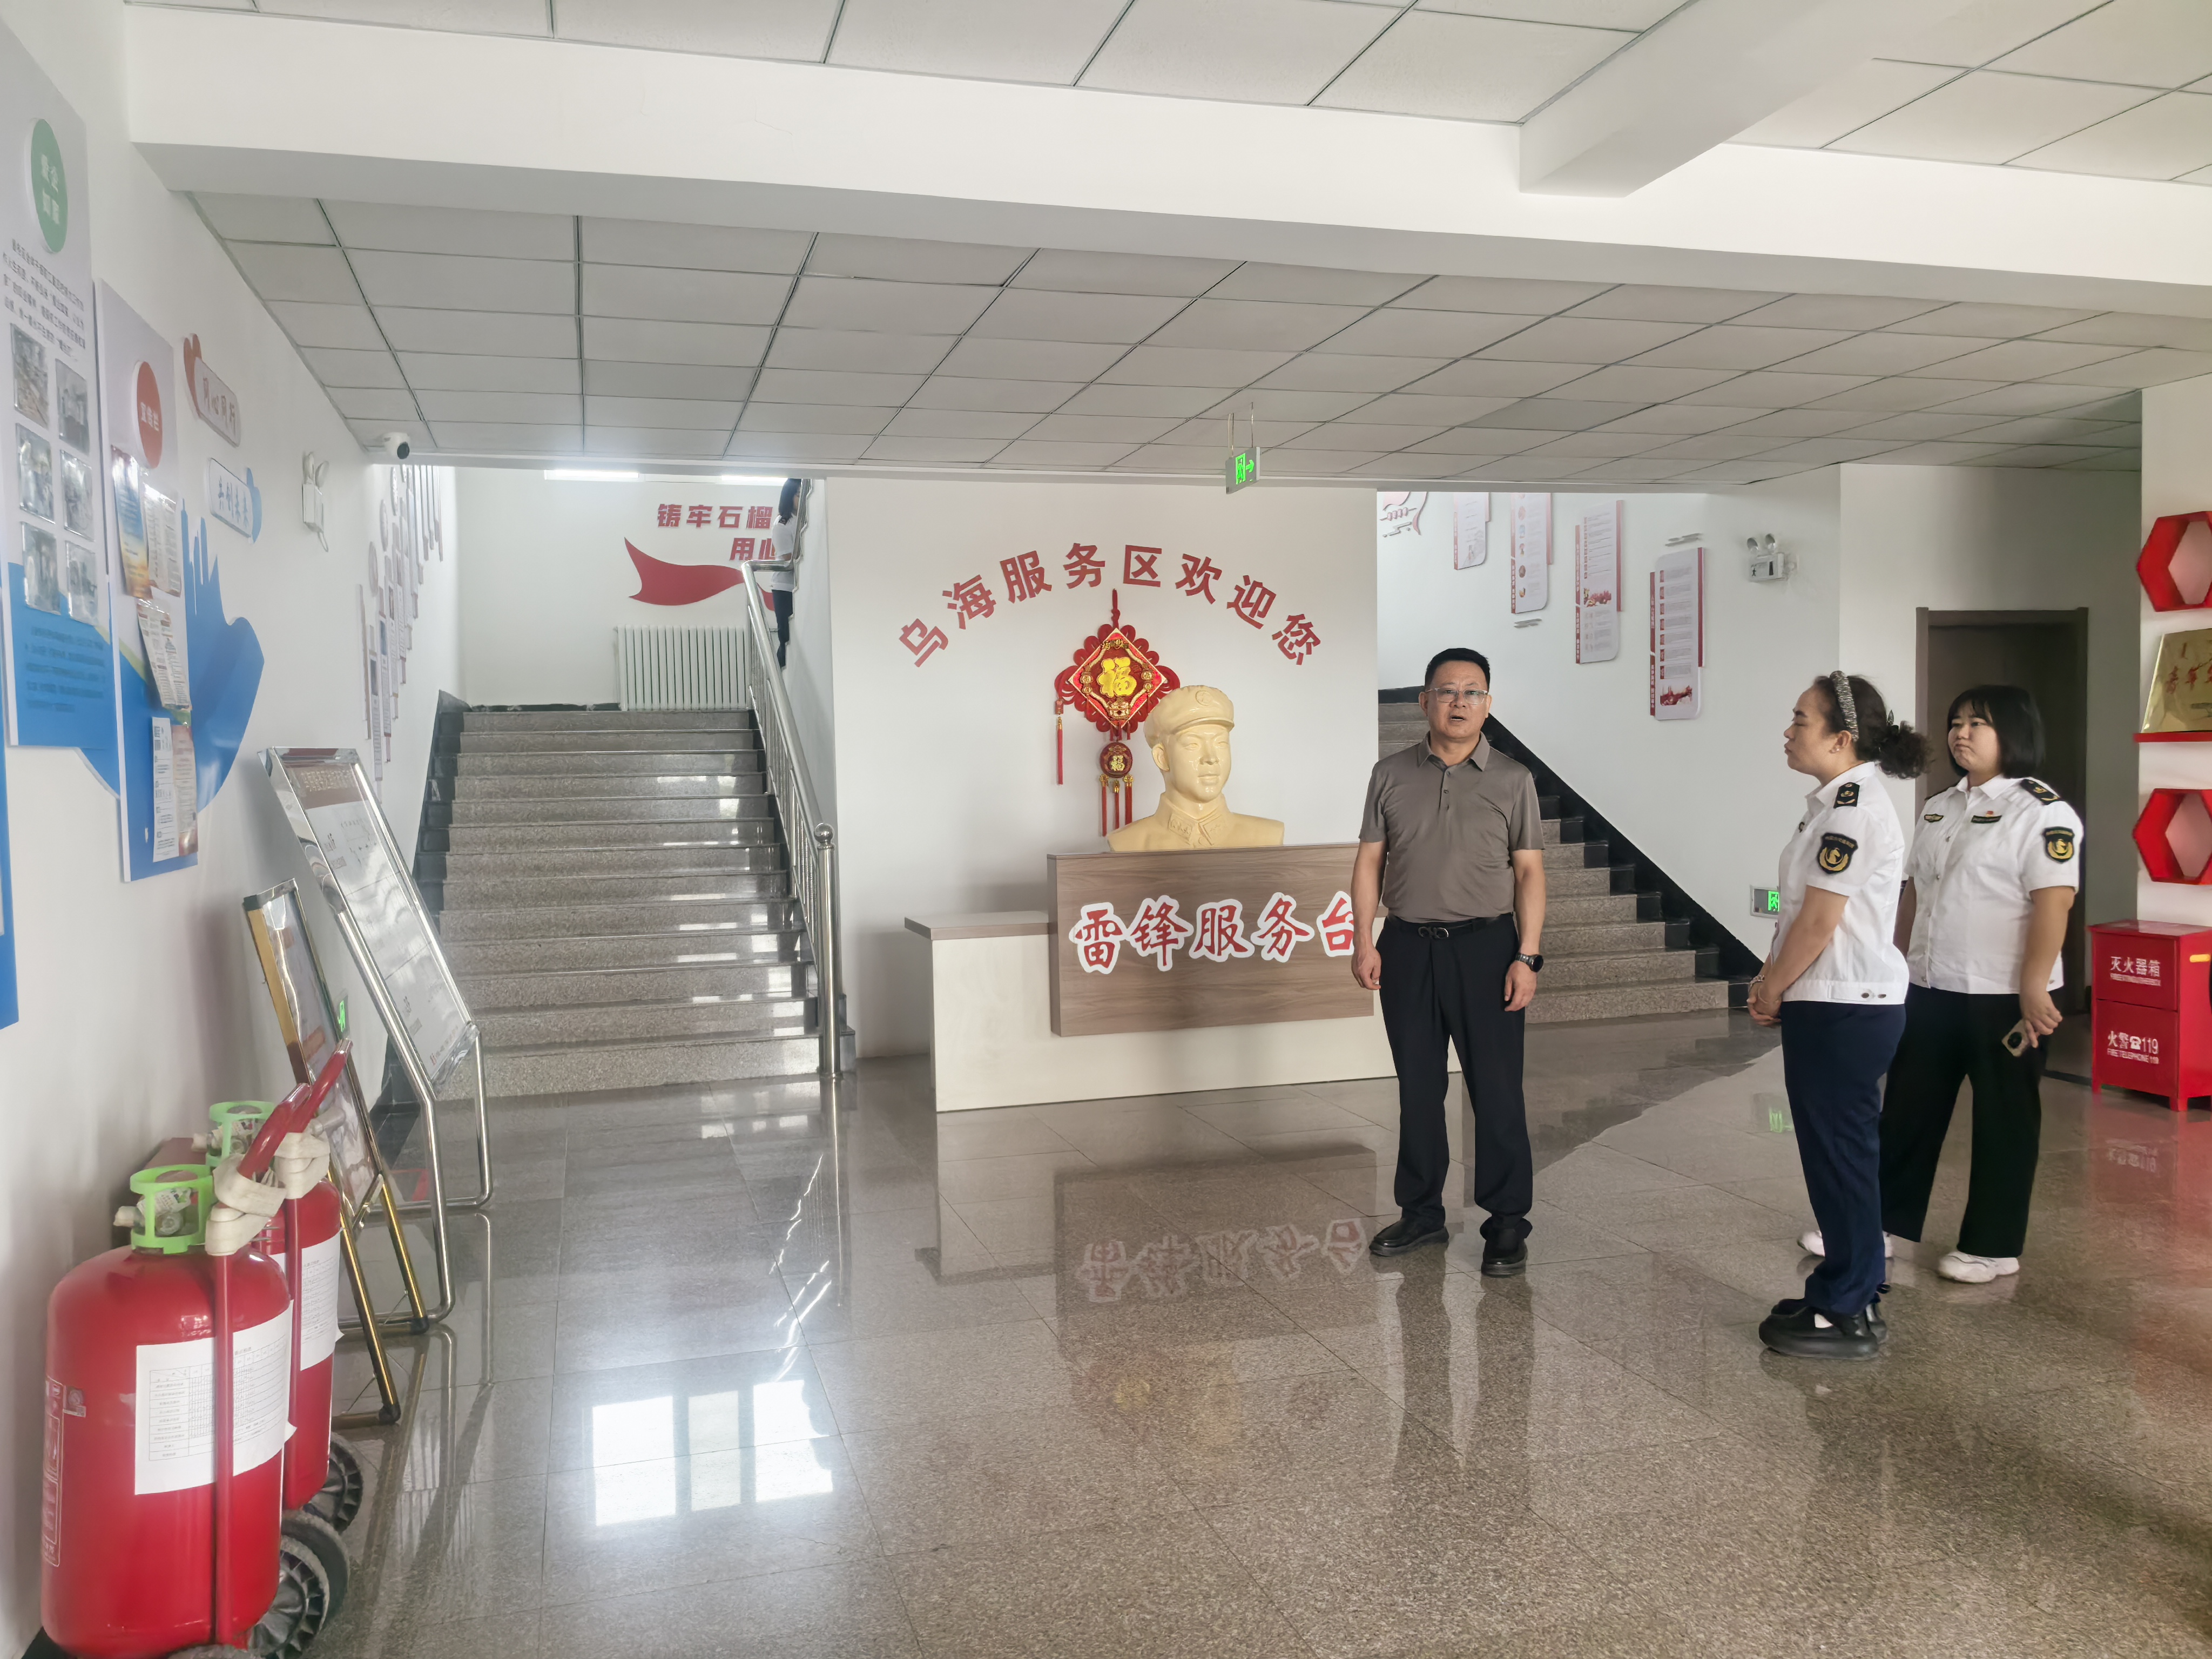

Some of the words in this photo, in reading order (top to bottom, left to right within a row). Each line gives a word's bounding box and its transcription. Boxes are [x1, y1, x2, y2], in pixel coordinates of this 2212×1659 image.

[657, 503, 773, 530] 铸牢石榴
[898, 542, 1321, 668] 乌海服务区欢迎您
[1097, 656, 1137, 698] 福
[1110, 754, 1125, 772] 福
[1071, 894, 1354, 970] 雷锋服务台
[2110, 956, 2161, 977] 灭火器箱
